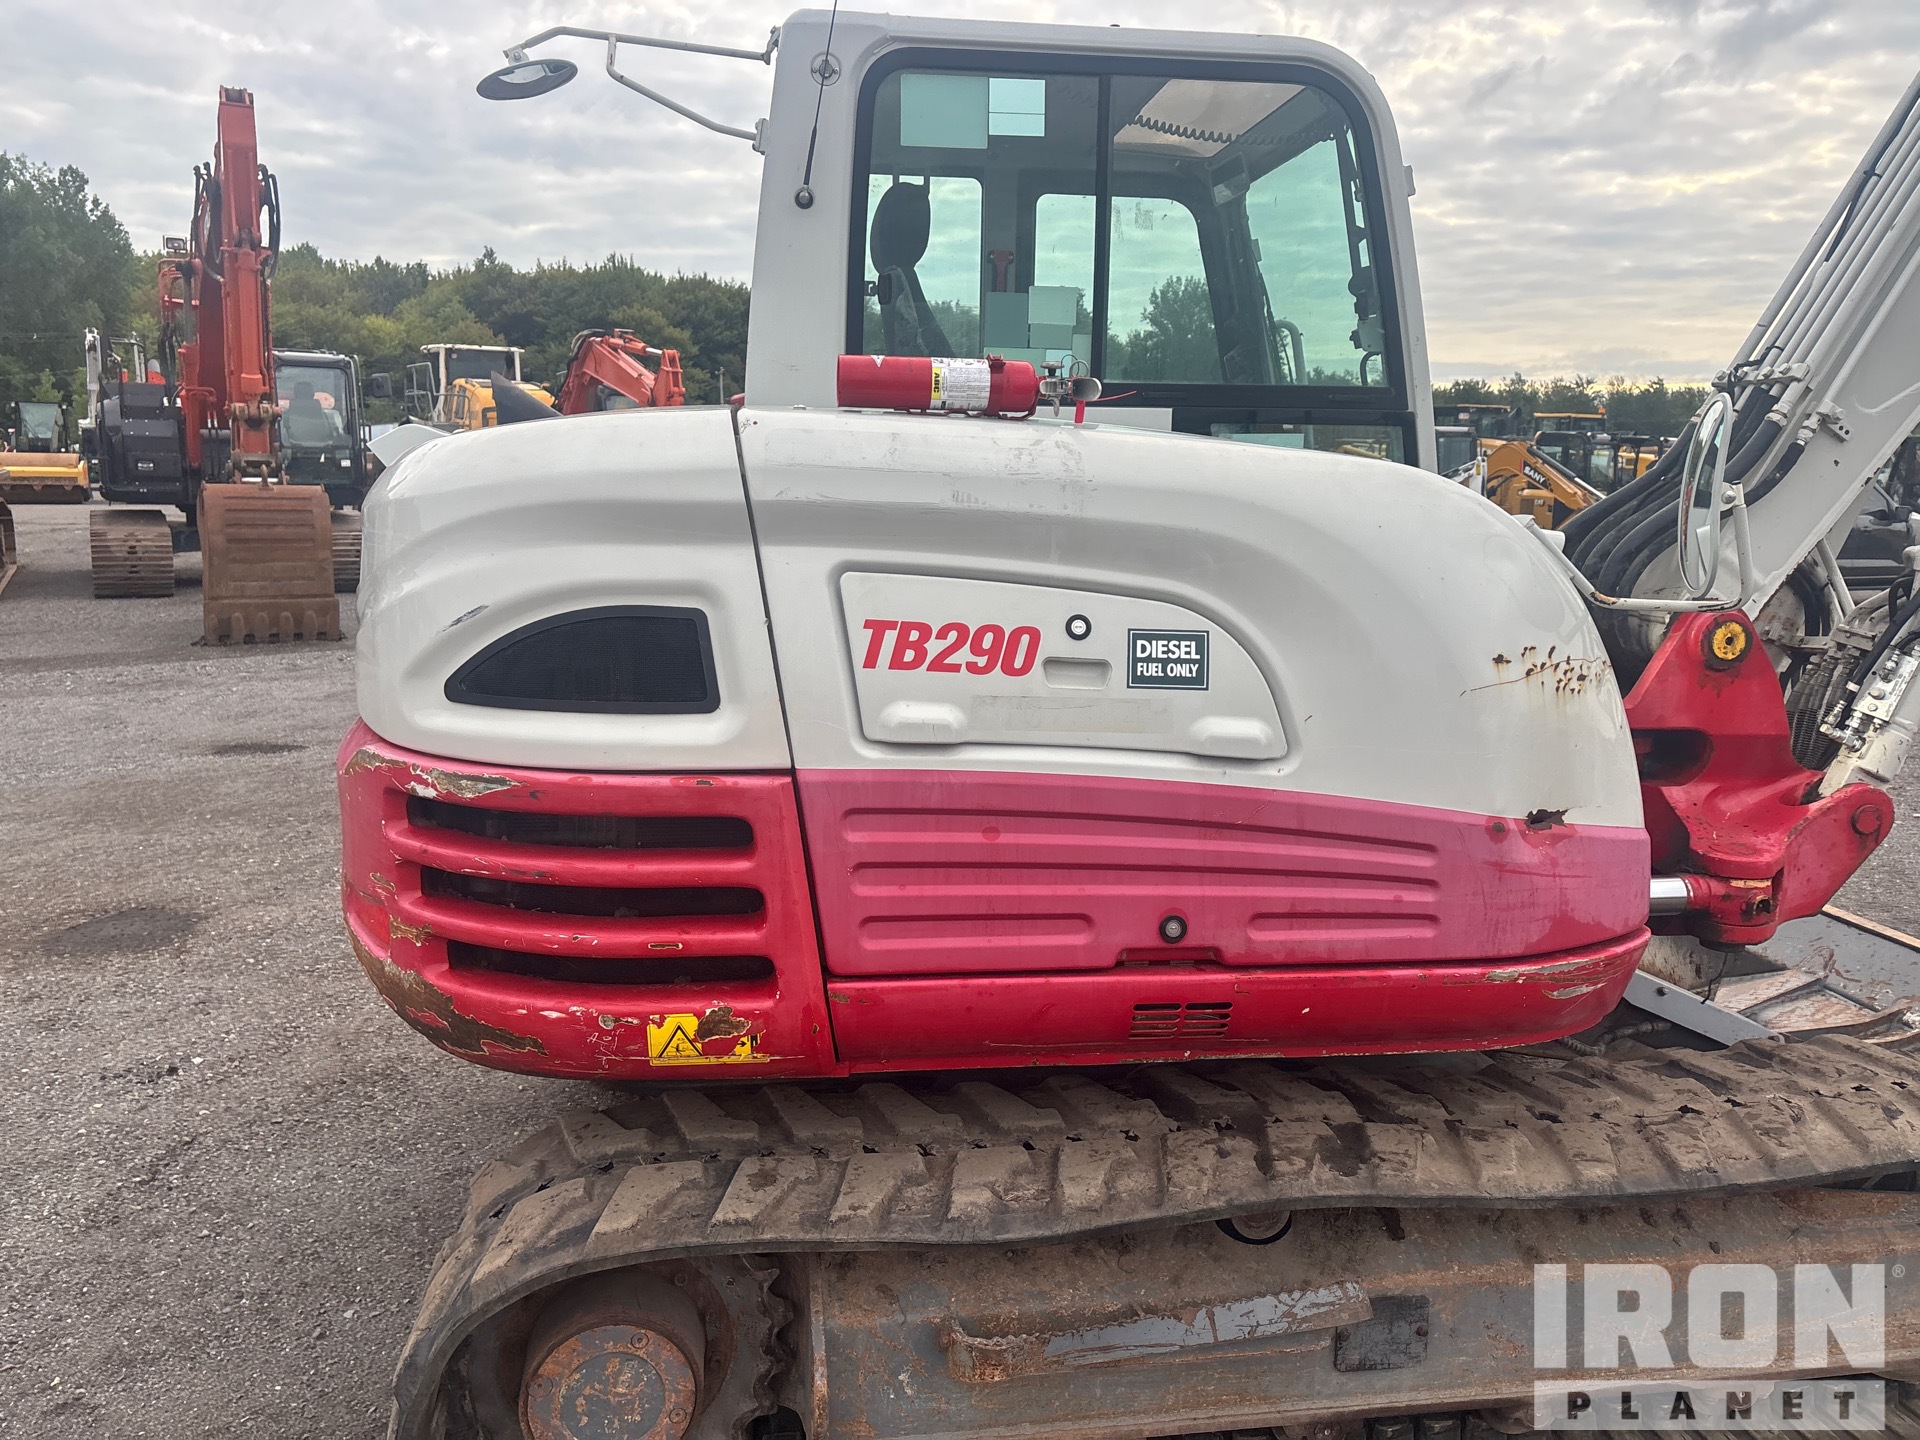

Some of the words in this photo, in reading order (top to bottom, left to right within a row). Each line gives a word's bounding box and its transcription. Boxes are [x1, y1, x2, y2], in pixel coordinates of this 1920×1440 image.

[1524, 466, 1546, 483] SANY
[862, 619, 1042, 677] TB290
[1136, 639, 1201, 659] DIESEL
[1136, 662, 1165, 677] FUEL
[1166, 663, 1200, 678] ONLY
